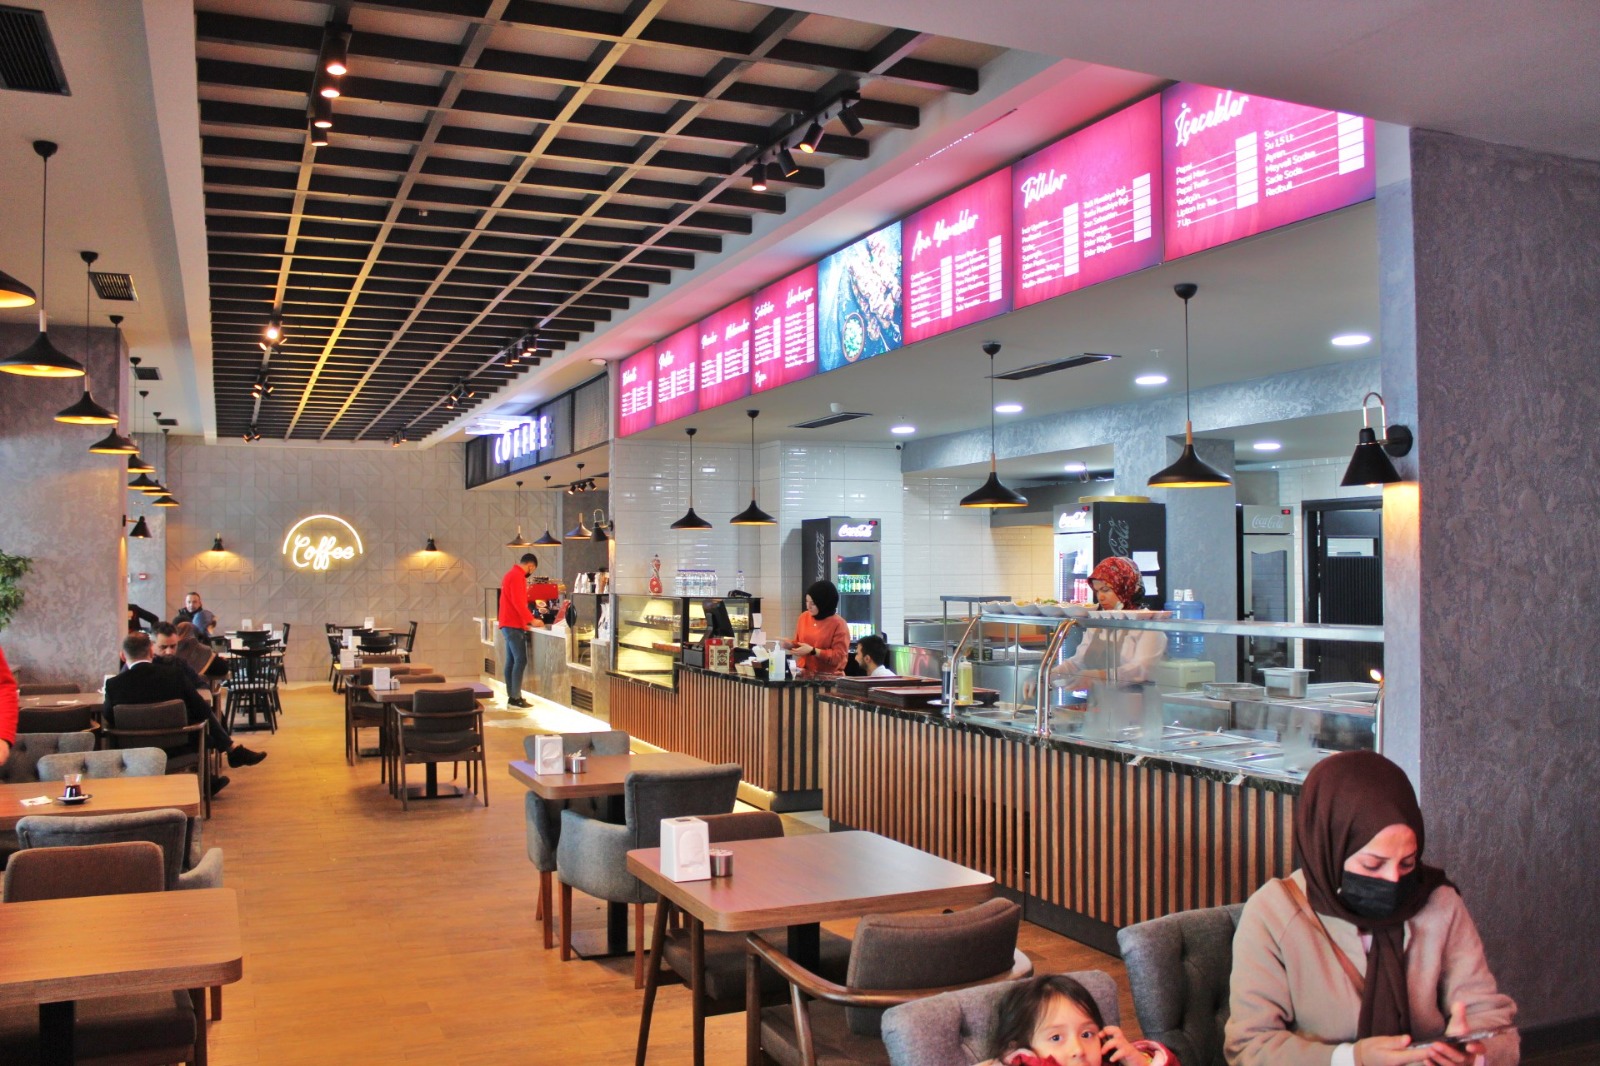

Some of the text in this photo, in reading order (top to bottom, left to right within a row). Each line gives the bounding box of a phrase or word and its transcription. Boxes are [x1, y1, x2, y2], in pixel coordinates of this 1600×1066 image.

[1264, 141, 1275, 151] Su
[494, 415, 548, 464] COFFEE
[292, 534, 355, 570] Coffee
